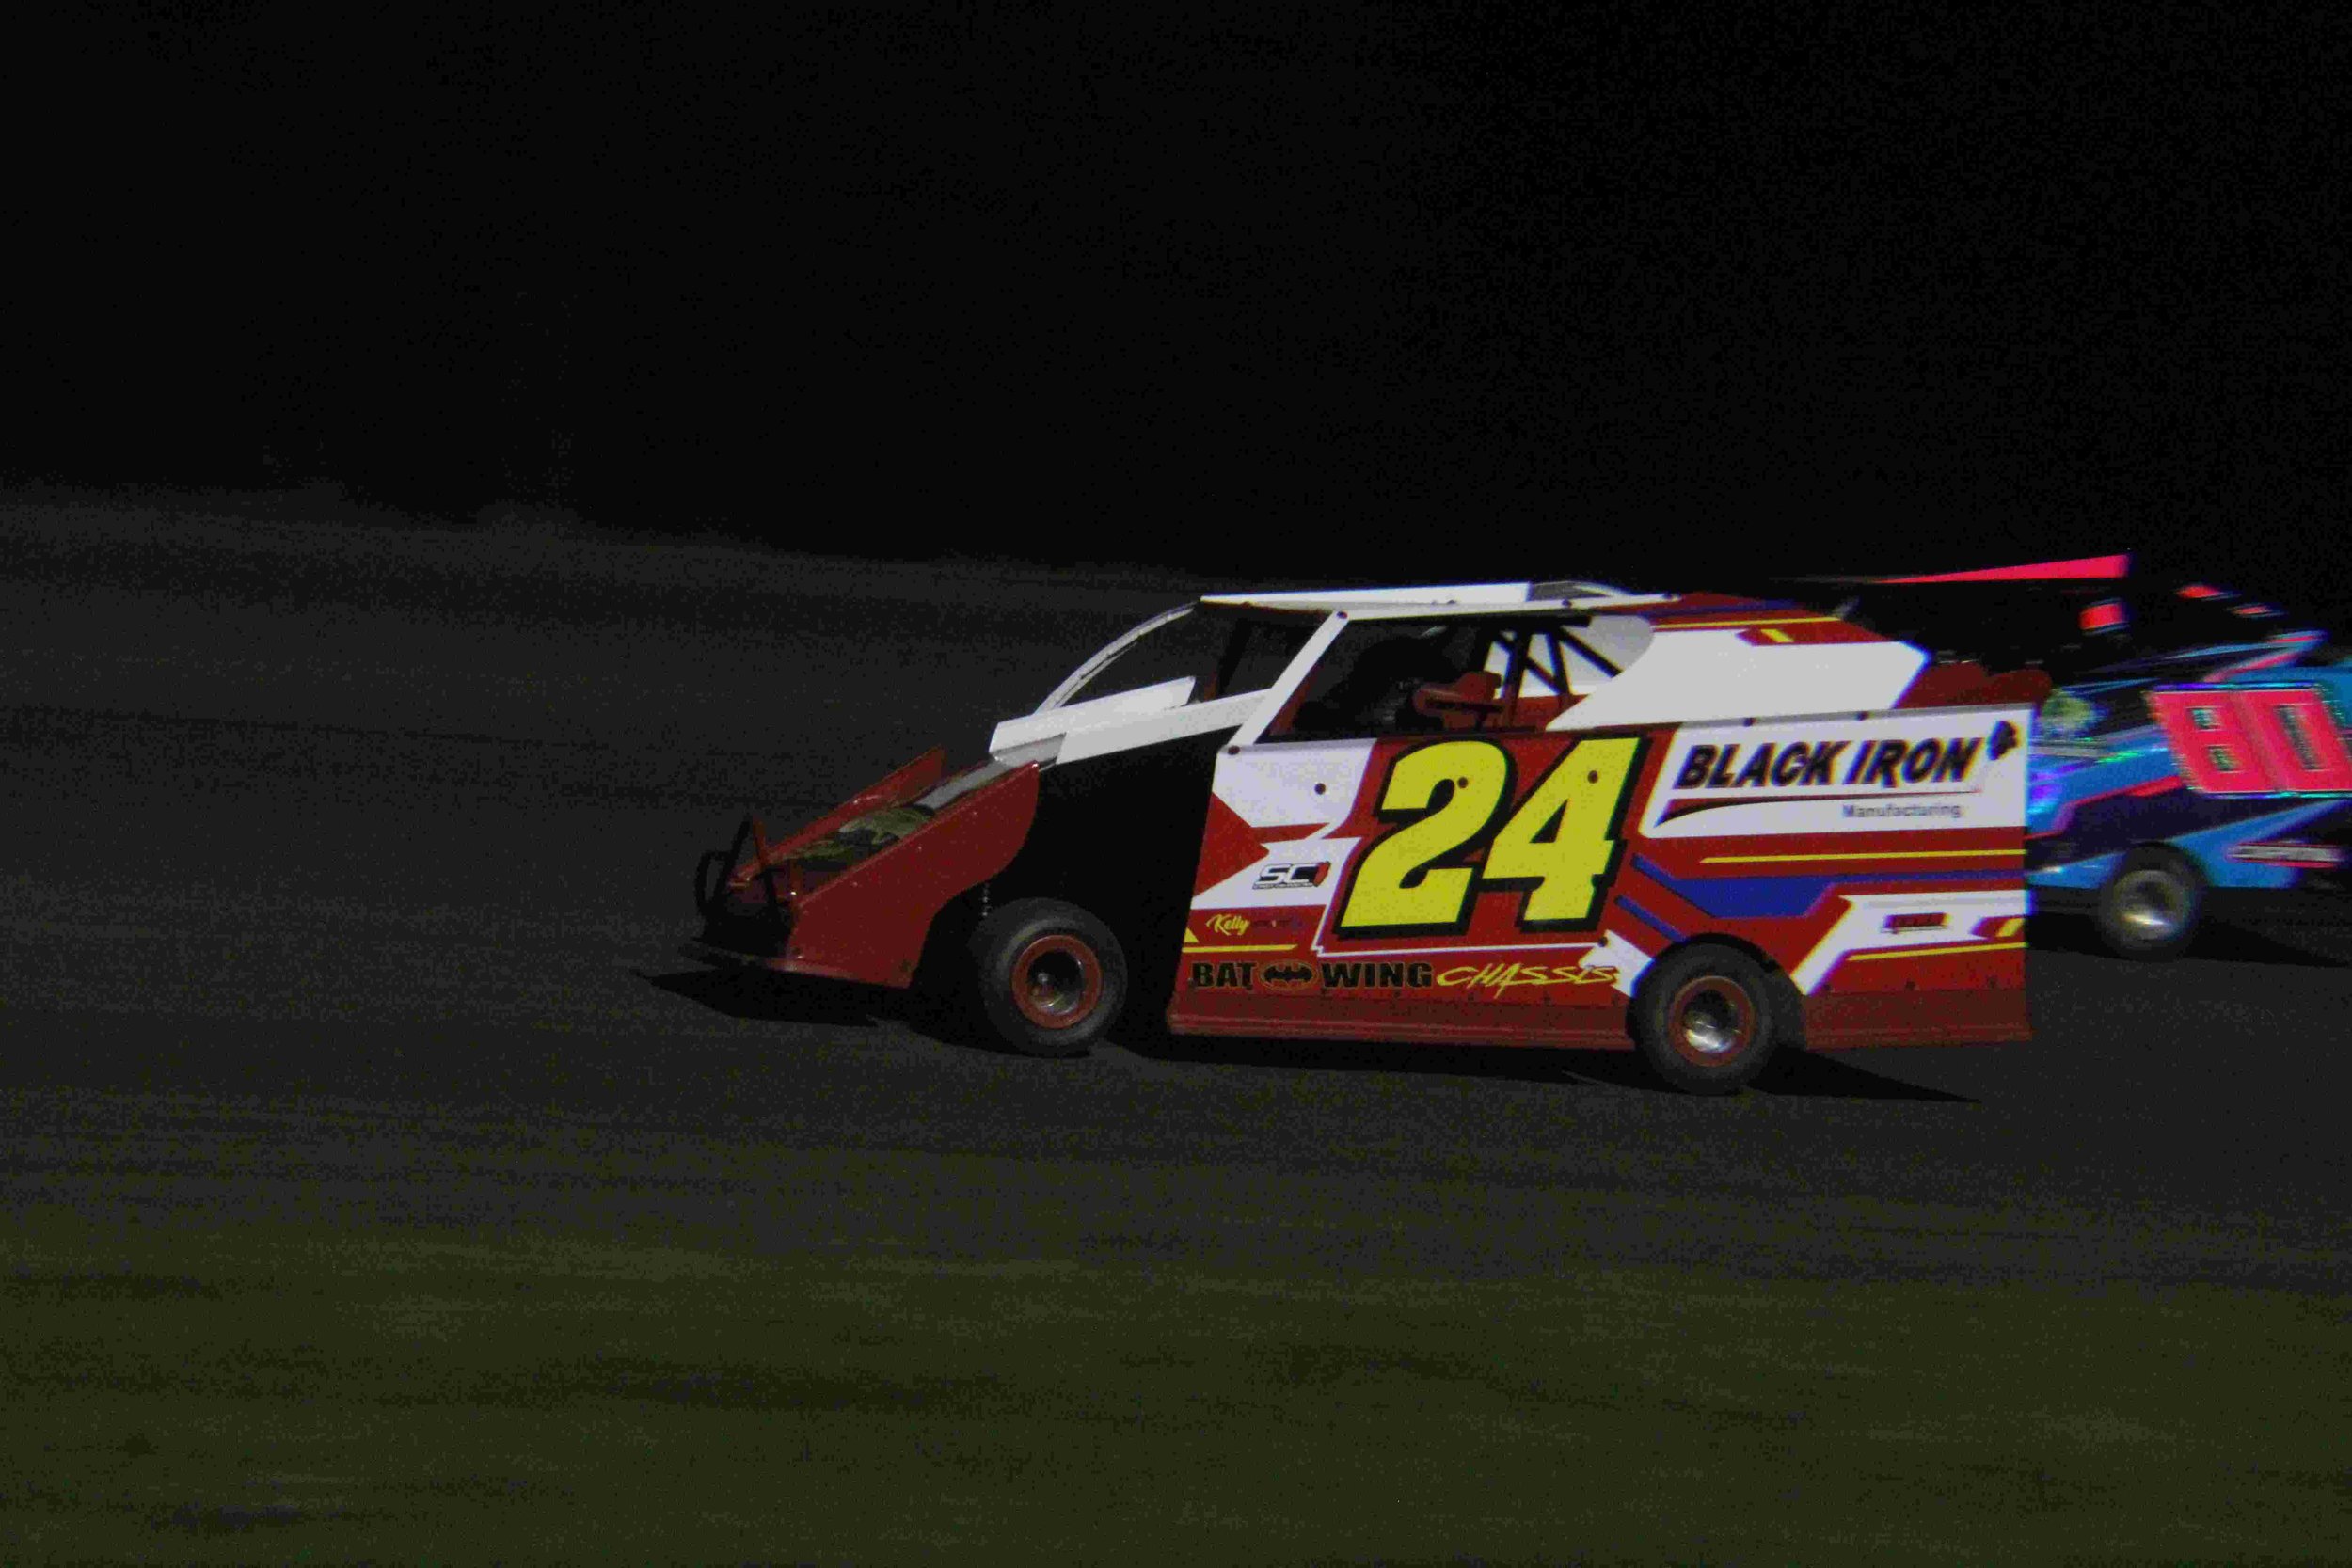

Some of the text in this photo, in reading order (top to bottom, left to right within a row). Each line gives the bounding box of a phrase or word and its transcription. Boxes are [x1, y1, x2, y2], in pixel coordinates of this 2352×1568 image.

[1673, 737, 1984, 790] BLACK IRON
[2152, 689, 2352, 793] 80
[1842, 804, 1963, 818] Manufacturing
[1336, 736, 1646, 932] 24
[1205, 913, 1250, 936] Kelly
[1190, 962, 1620, 999] BAT WING CHASSIS
